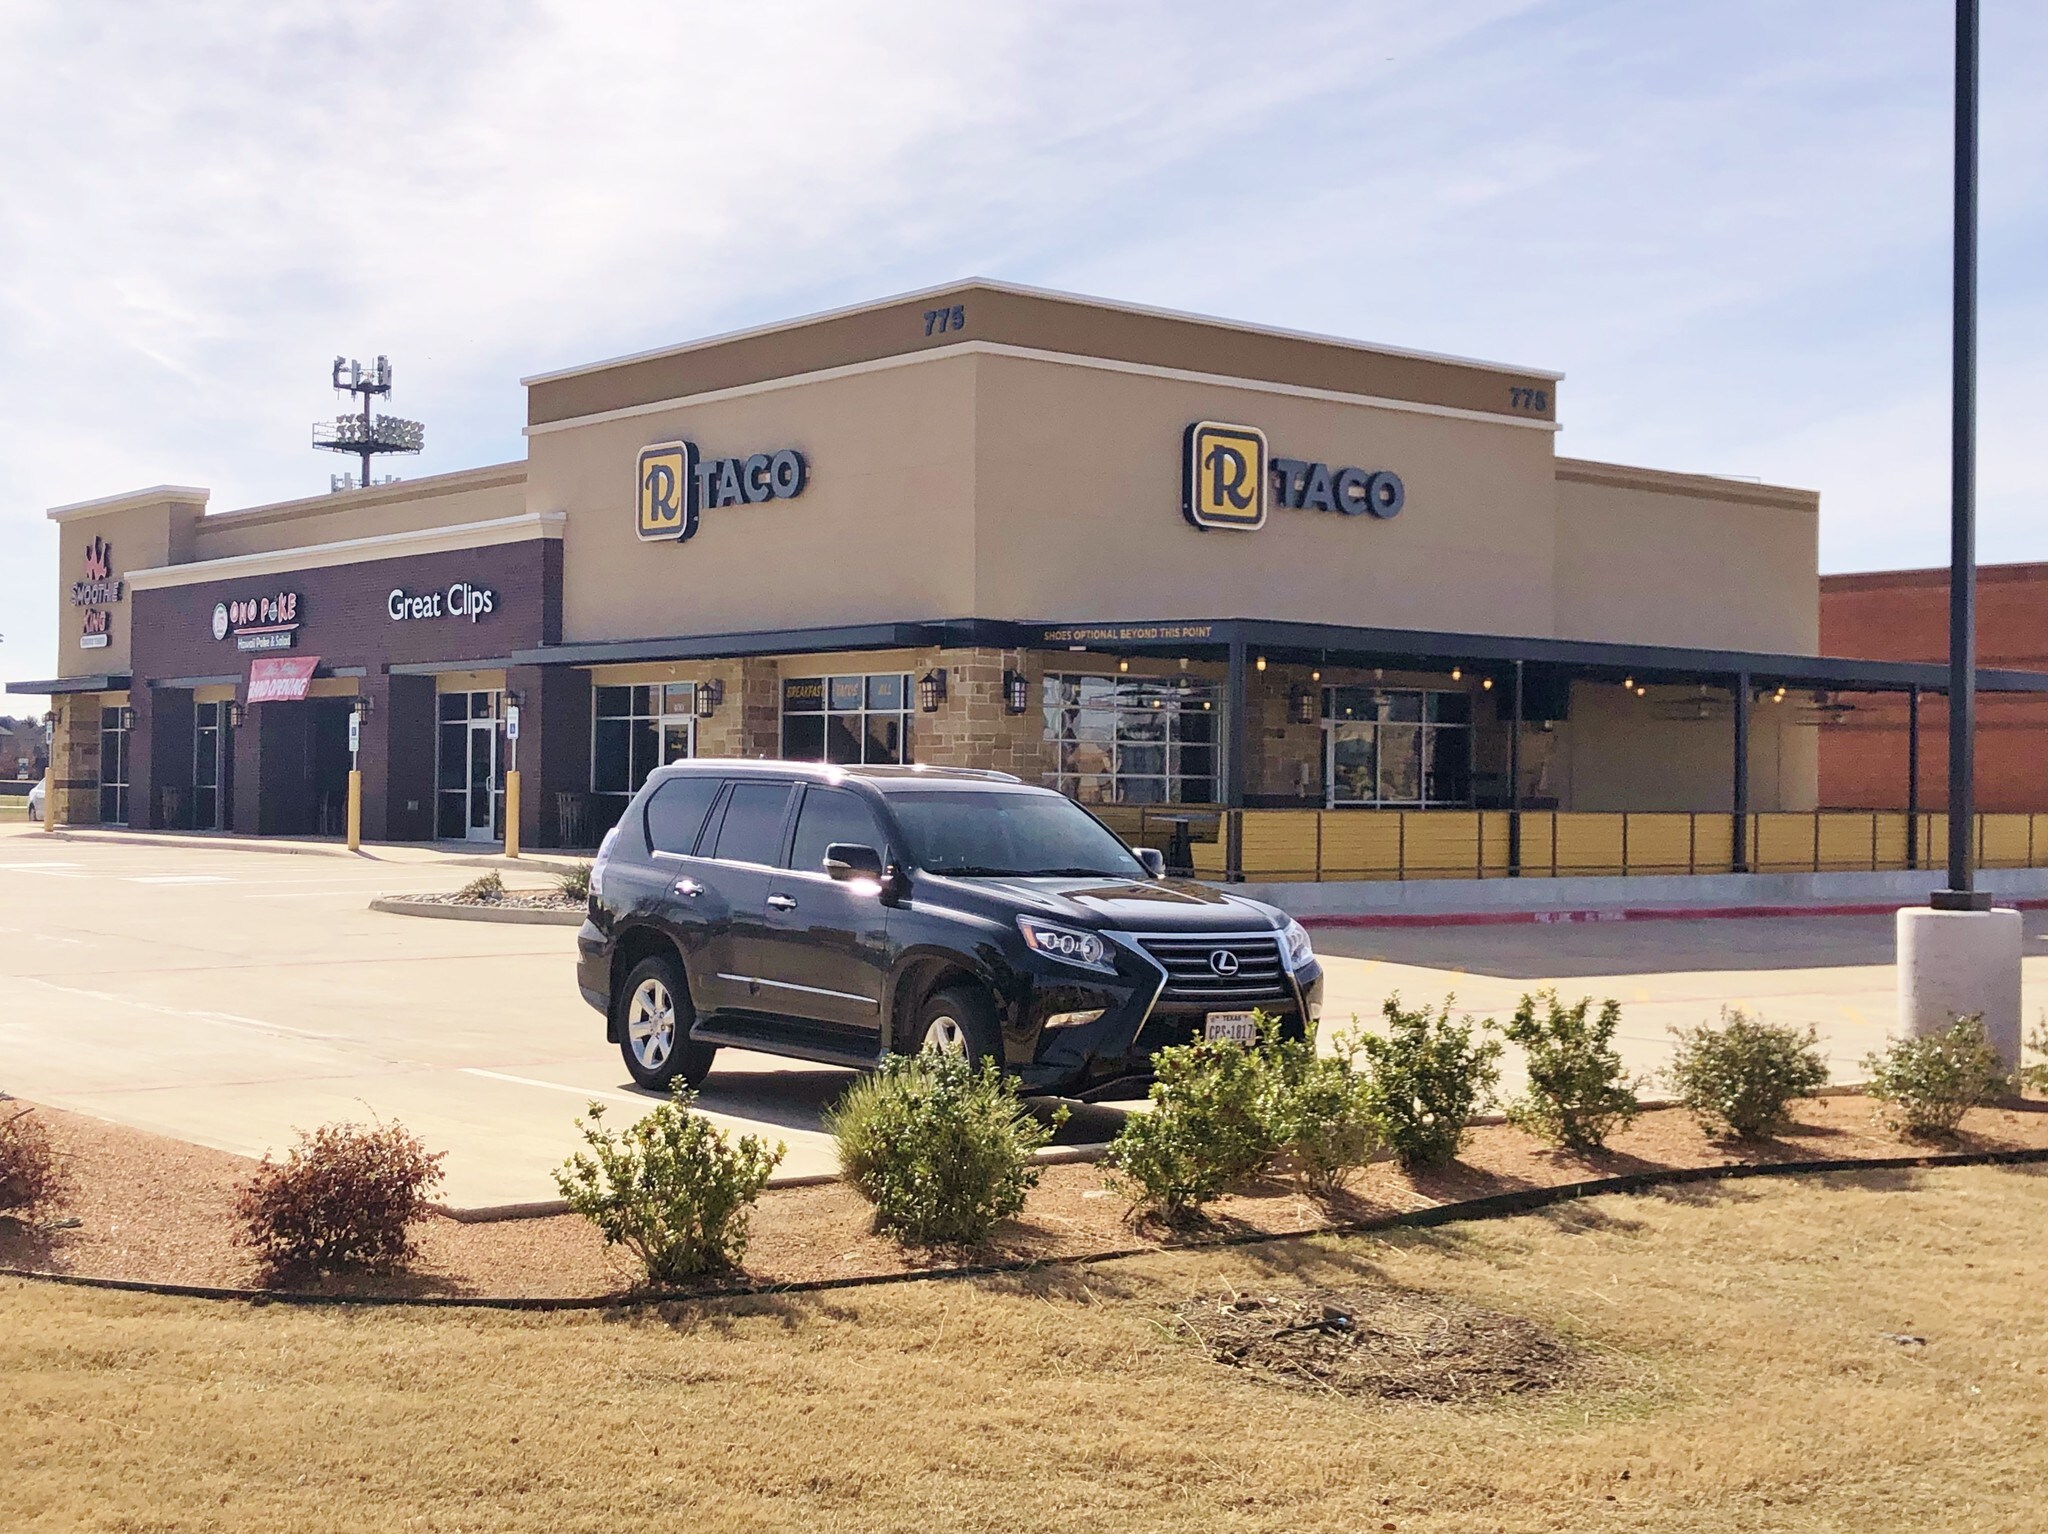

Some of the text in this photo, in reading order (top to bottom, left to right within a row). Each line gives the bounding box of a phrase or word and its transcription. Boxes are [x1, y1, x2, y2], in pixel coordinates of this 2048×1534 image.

[923, 304, 965, 337] 775
[645, 449, 806, 521] R TACO
[1204, 444, 1405, 519] R TACO
[70, 581, 120, 606] SMOOTHE
[388, 583, 493, 623] Great Clips
[1044, 626, 1212, 641] SHOES OPTIONAL BEYOND THIS POINT
[268, 677, 308, 697] OPENING
[786, 683, 826, 699] BREAKFAST
